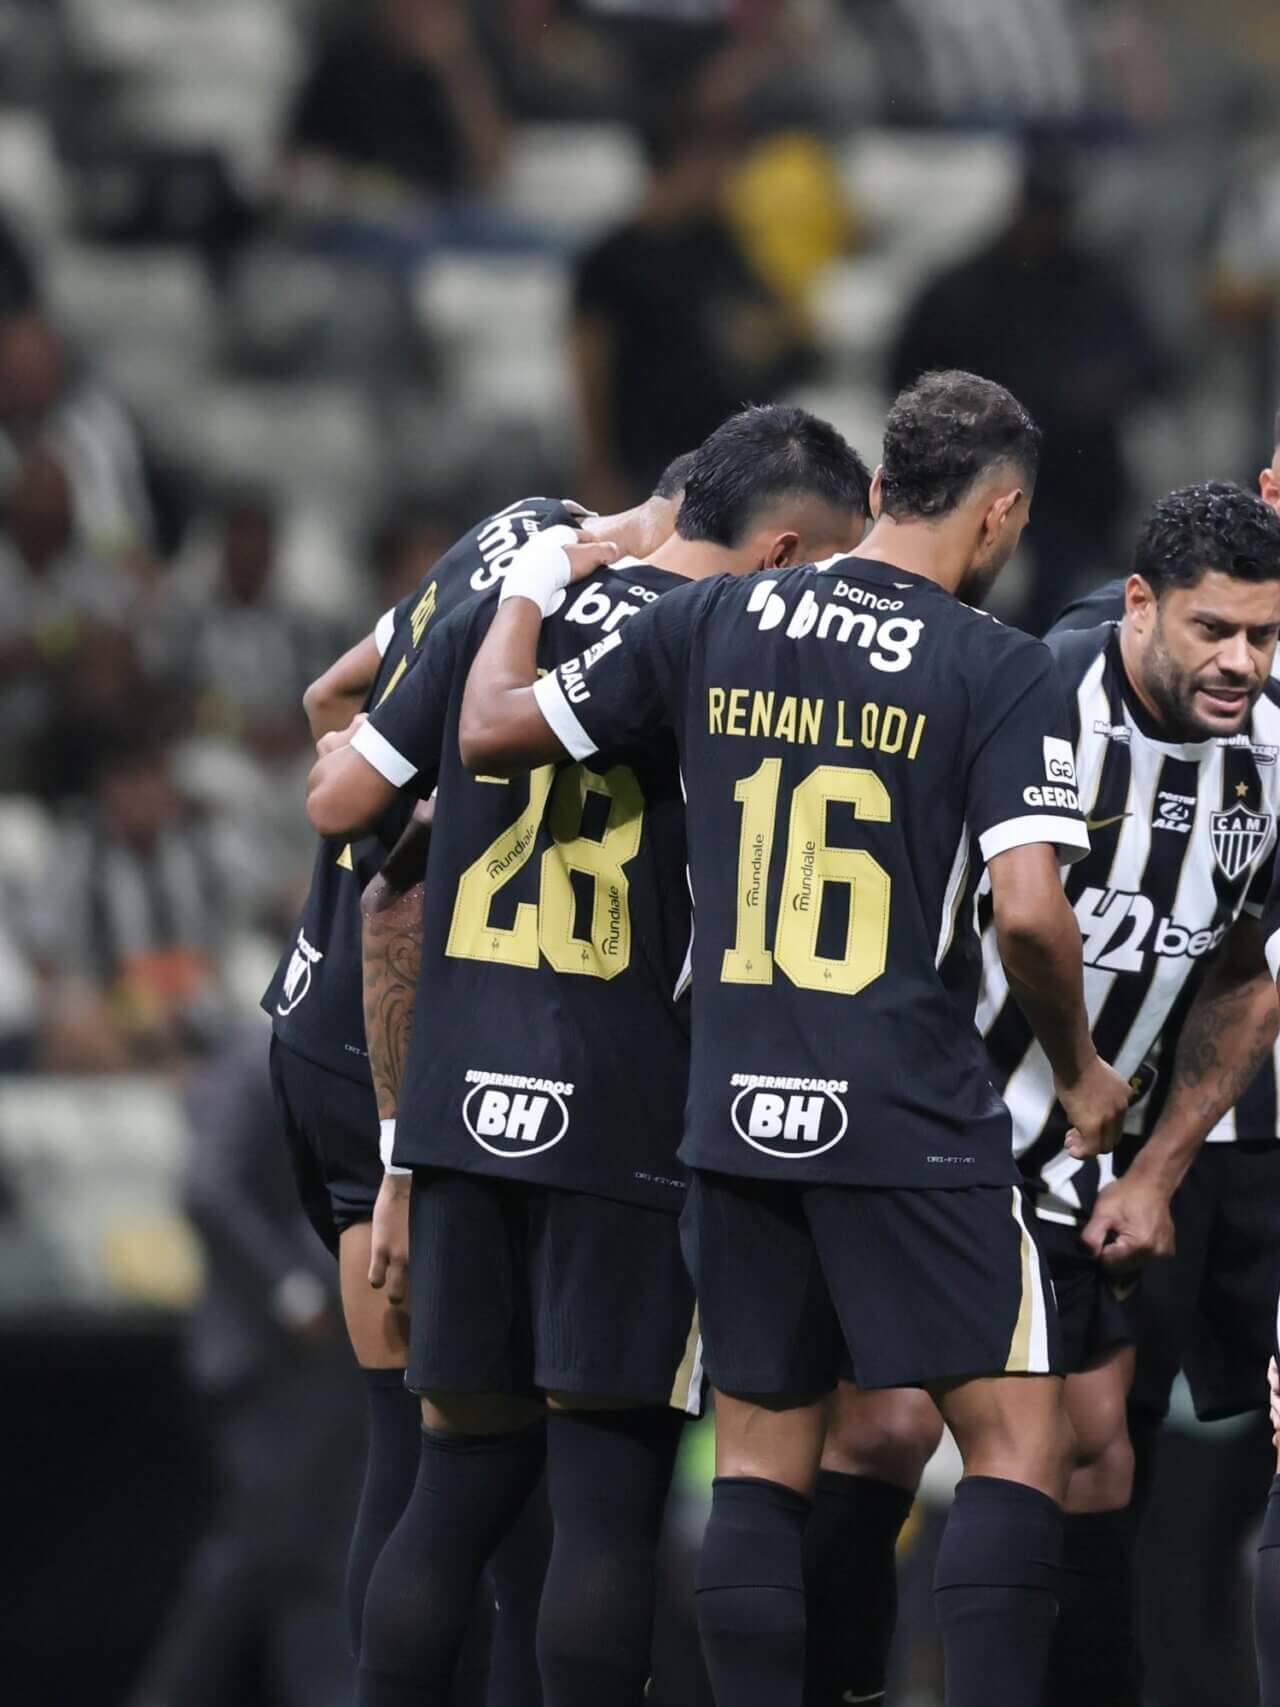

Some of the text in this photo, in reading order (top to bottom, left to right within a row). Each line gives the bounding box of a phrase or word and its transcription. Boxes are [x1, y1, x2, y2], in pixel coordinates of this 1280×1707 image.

[833, 580, 904, 611] banco
[786, 590, 924, 673] bmg
[708, 687, 927, 759] RENAN LODI
[486, 824, 536, 880] mundiale
[1217, 817, 1261, 831] CAM
[445, 763, 645, 981] 28
[720, 758, 892, 996] 16
[745, 832, 765, 908] mundiale
[792, 840, 816, 912] mundiale
[601, 885, 620, 956] mundiale
[465, 1069, 575, 1097] SUPERMERCADOS
[730, 1073, 849, 1094] SUPERMERCADOS
[475, 1091, 549, 1142] BH
[748, 1093, 825, 1142] BH
